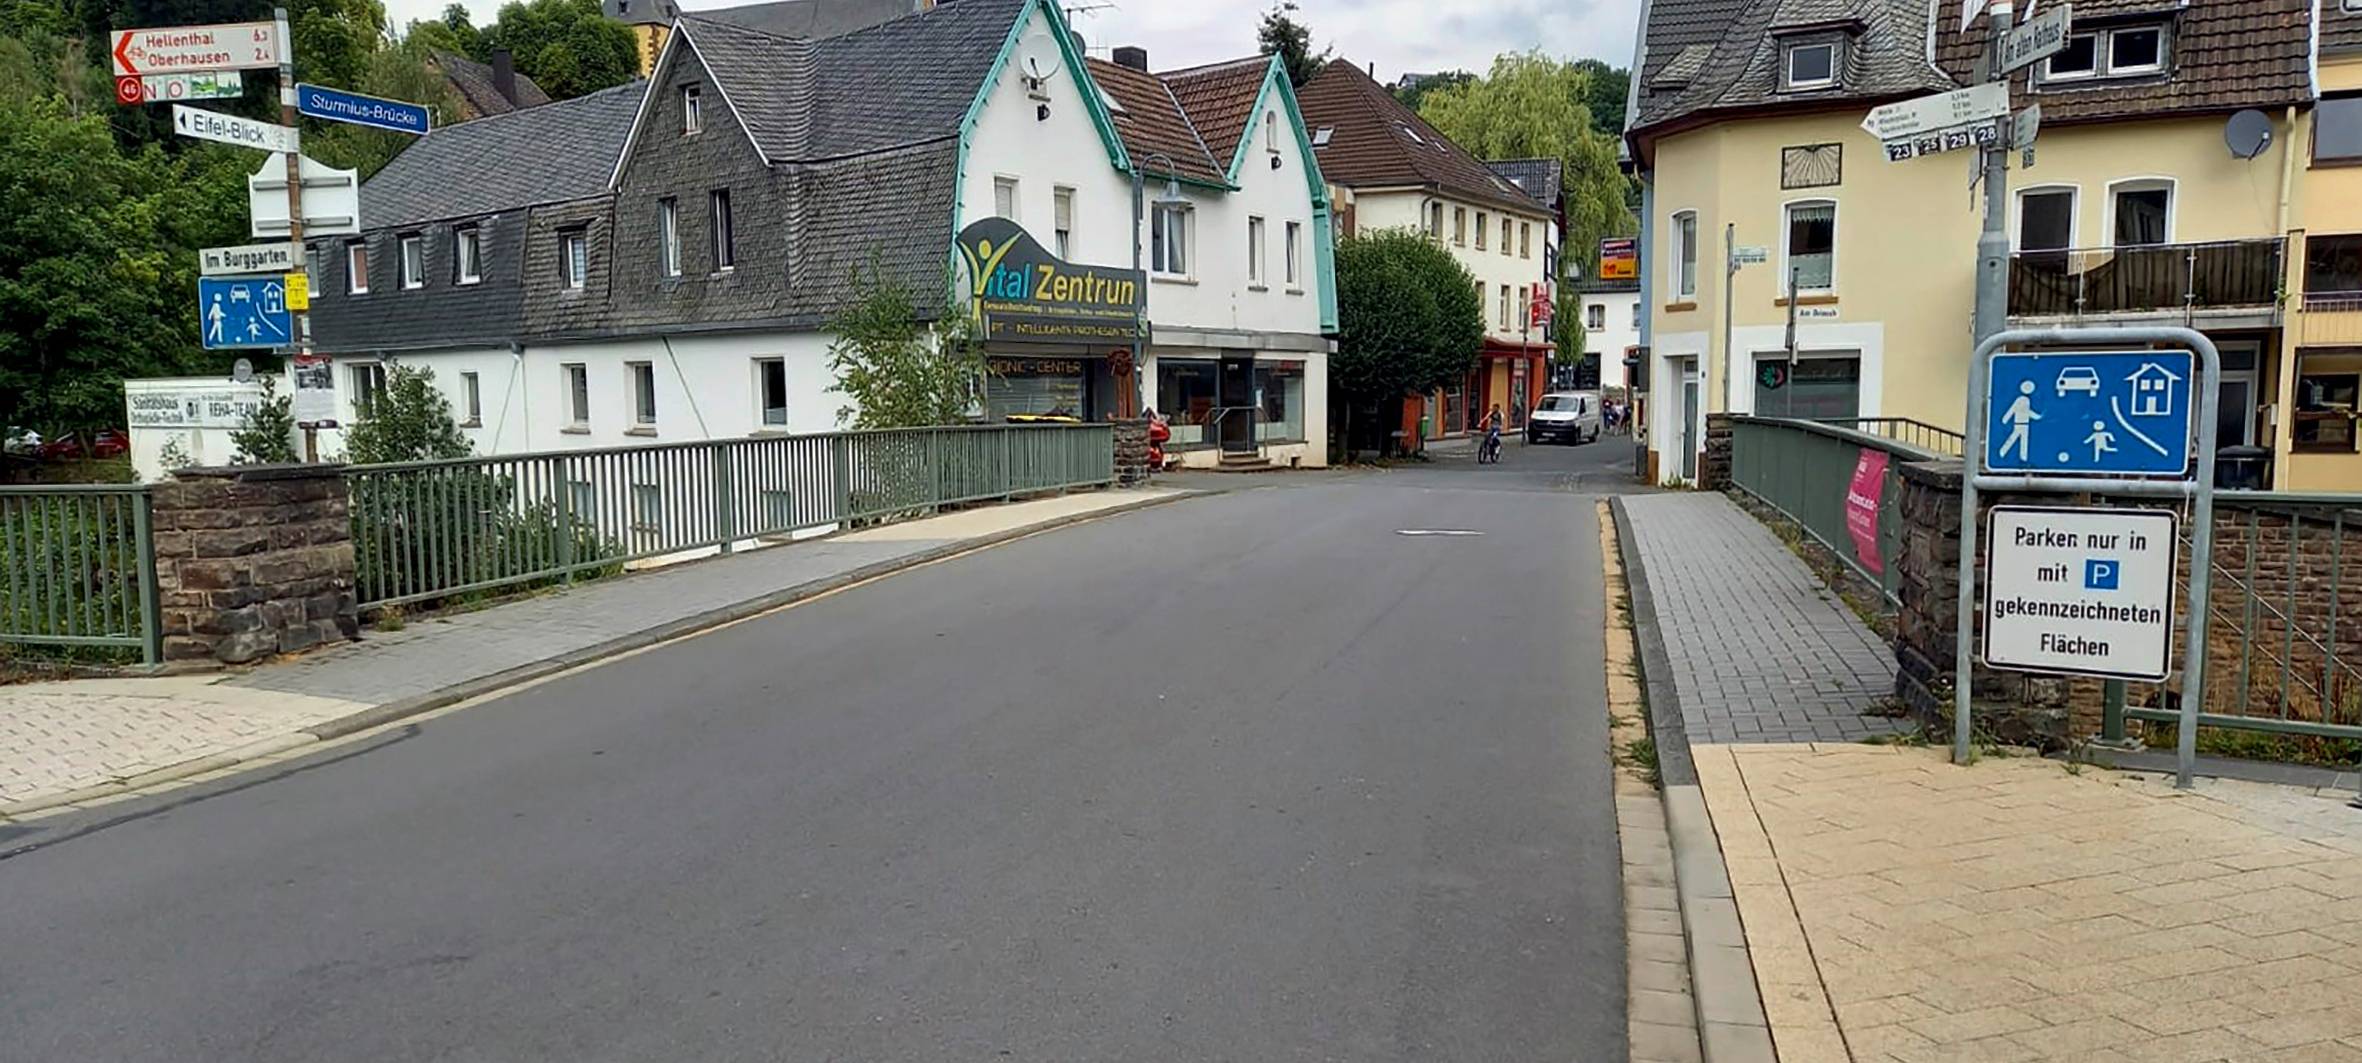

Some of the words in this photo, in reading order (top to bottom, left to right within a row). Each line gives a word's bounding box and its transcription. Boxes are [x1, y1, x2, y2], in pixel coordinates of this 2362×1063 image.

[146, 31, 214, 48] Hellenthal
[149, 50, 230, 67] Oberhausen
[311, 94, 417, 126] Sturmius-Brücke
[194, 114, 265, 143] Eifel-Blick
[1893, 146, 1910, 159] 23
[1950, 134, 1967, 148] 29
[1979, 127, 1997, 142] 28
[205, 253, 220, 267] Im
[224, 249, 287, 270] Burggarten
[2014, 527, 2078, 550] Parken
[2088, 533, 2119, 550] nur
[2129, 532, 2147, 551] in
[2037, 563, 2068, 583] mit
[2092, 564, 2111, 586] P
[1994, 600, 2161, 624] gekennzeichneten
[2040, 633, 2109, 657] Flächen
